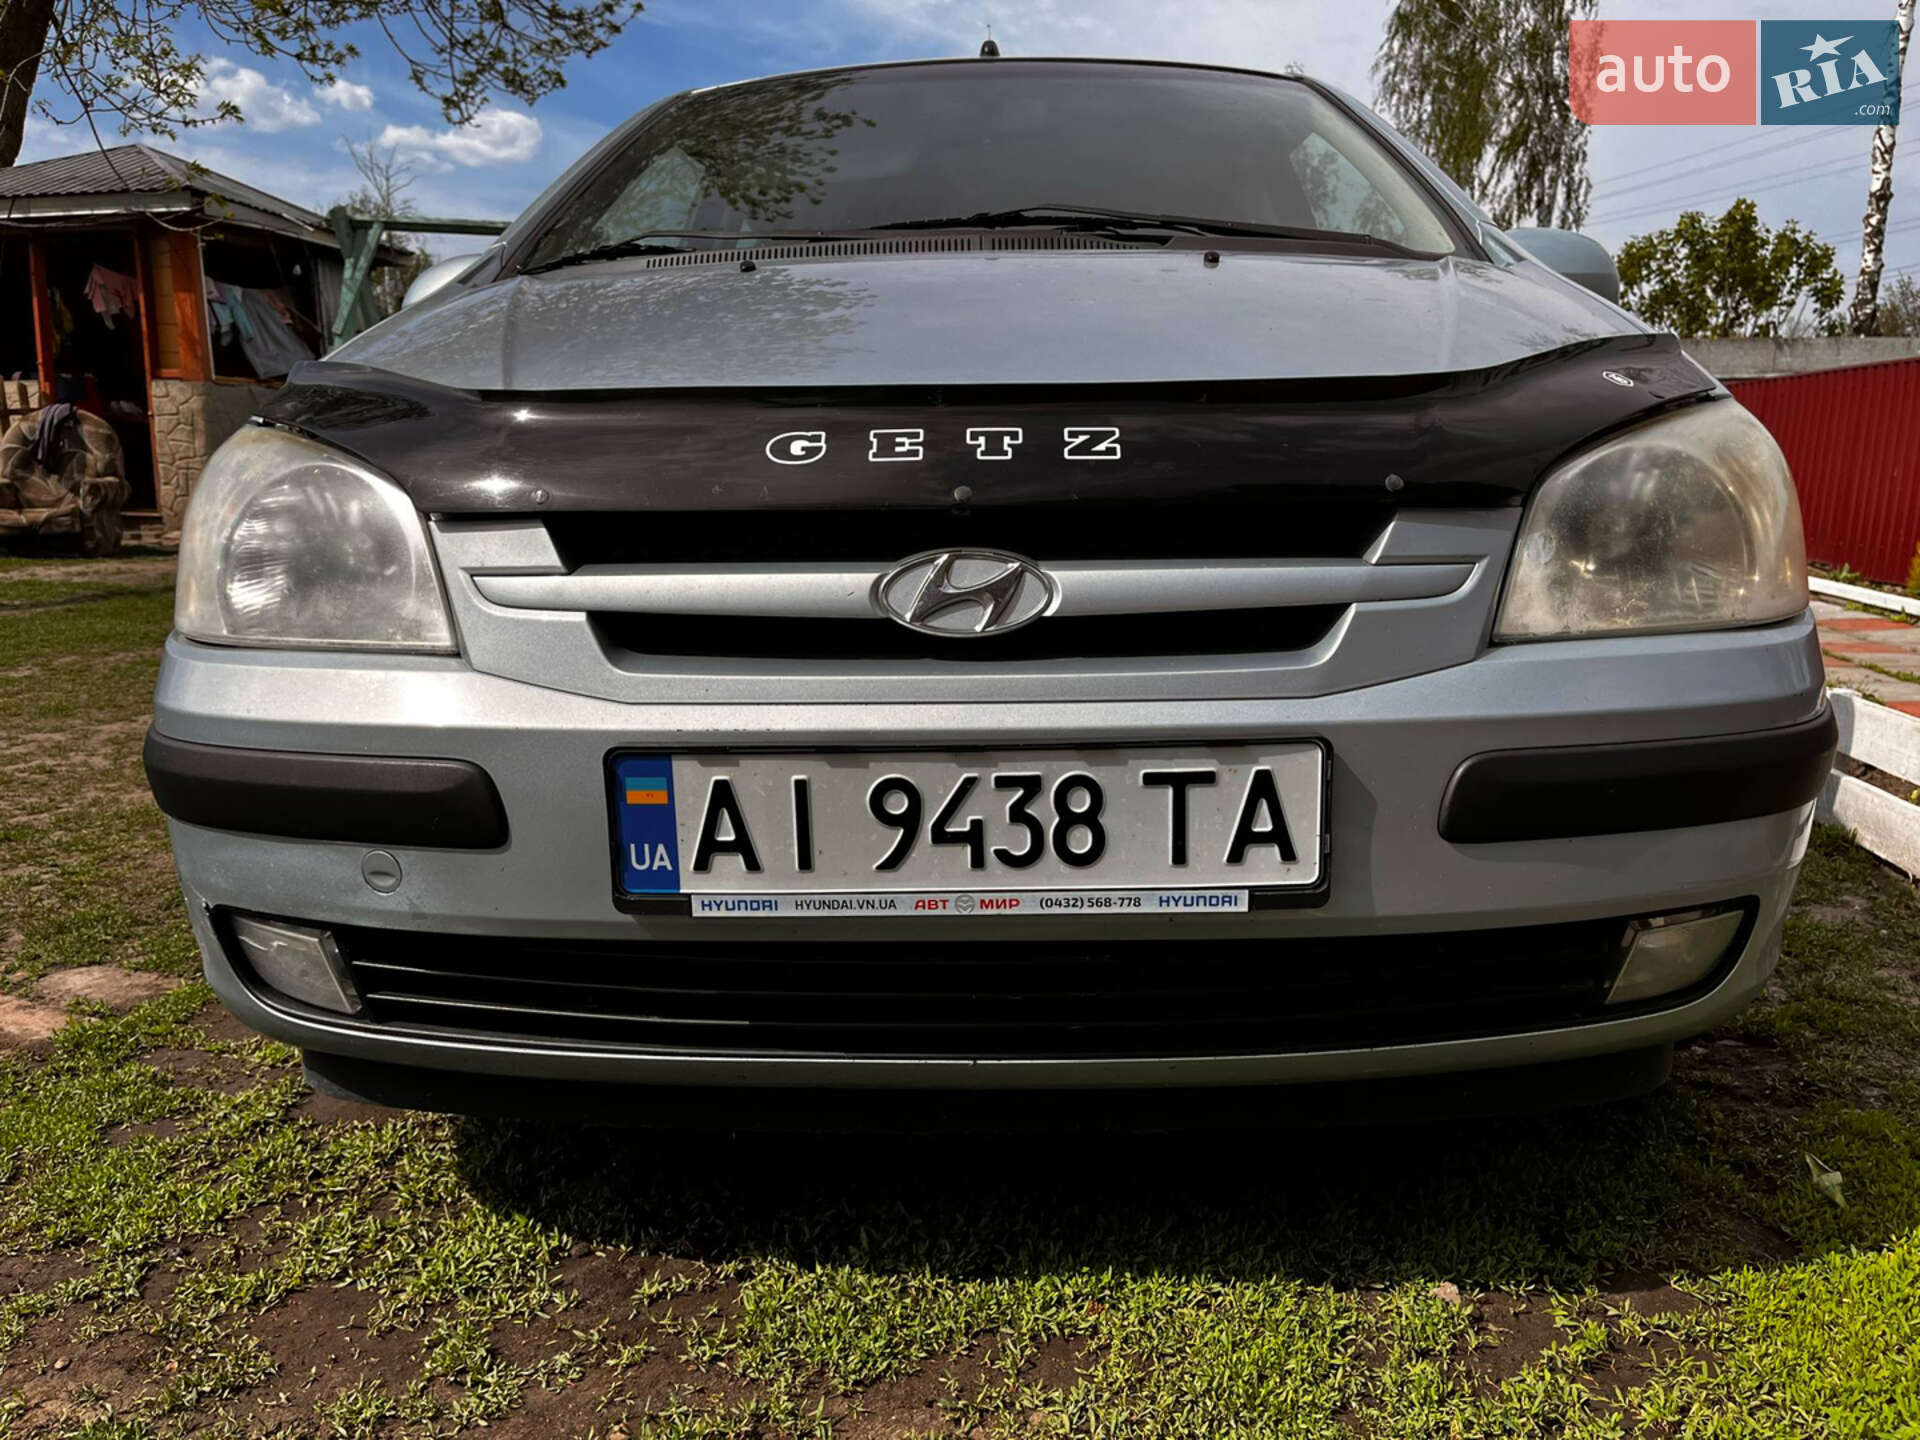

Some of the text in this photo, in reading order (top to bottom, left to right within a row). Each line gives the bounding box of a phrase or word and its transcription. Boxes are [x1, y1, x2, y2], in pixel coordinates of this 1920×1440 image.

[766, 427, 1121, 465] GETZ
[692, 767, 1298, 872] AI 9438 TA
[630, 843, 673, 871] UA
[701, 899, 778, 911] HYUNDAI
[794, 899, 897, 911] HYUNDAI.VN.UA
[979, 898, 1020, 910] МИР
[1039, 897, 1084, 909] (0432)
[1087, 897, 1142, 908] 568-778
[1158, 895, 1238, 907] HYUNDAI
